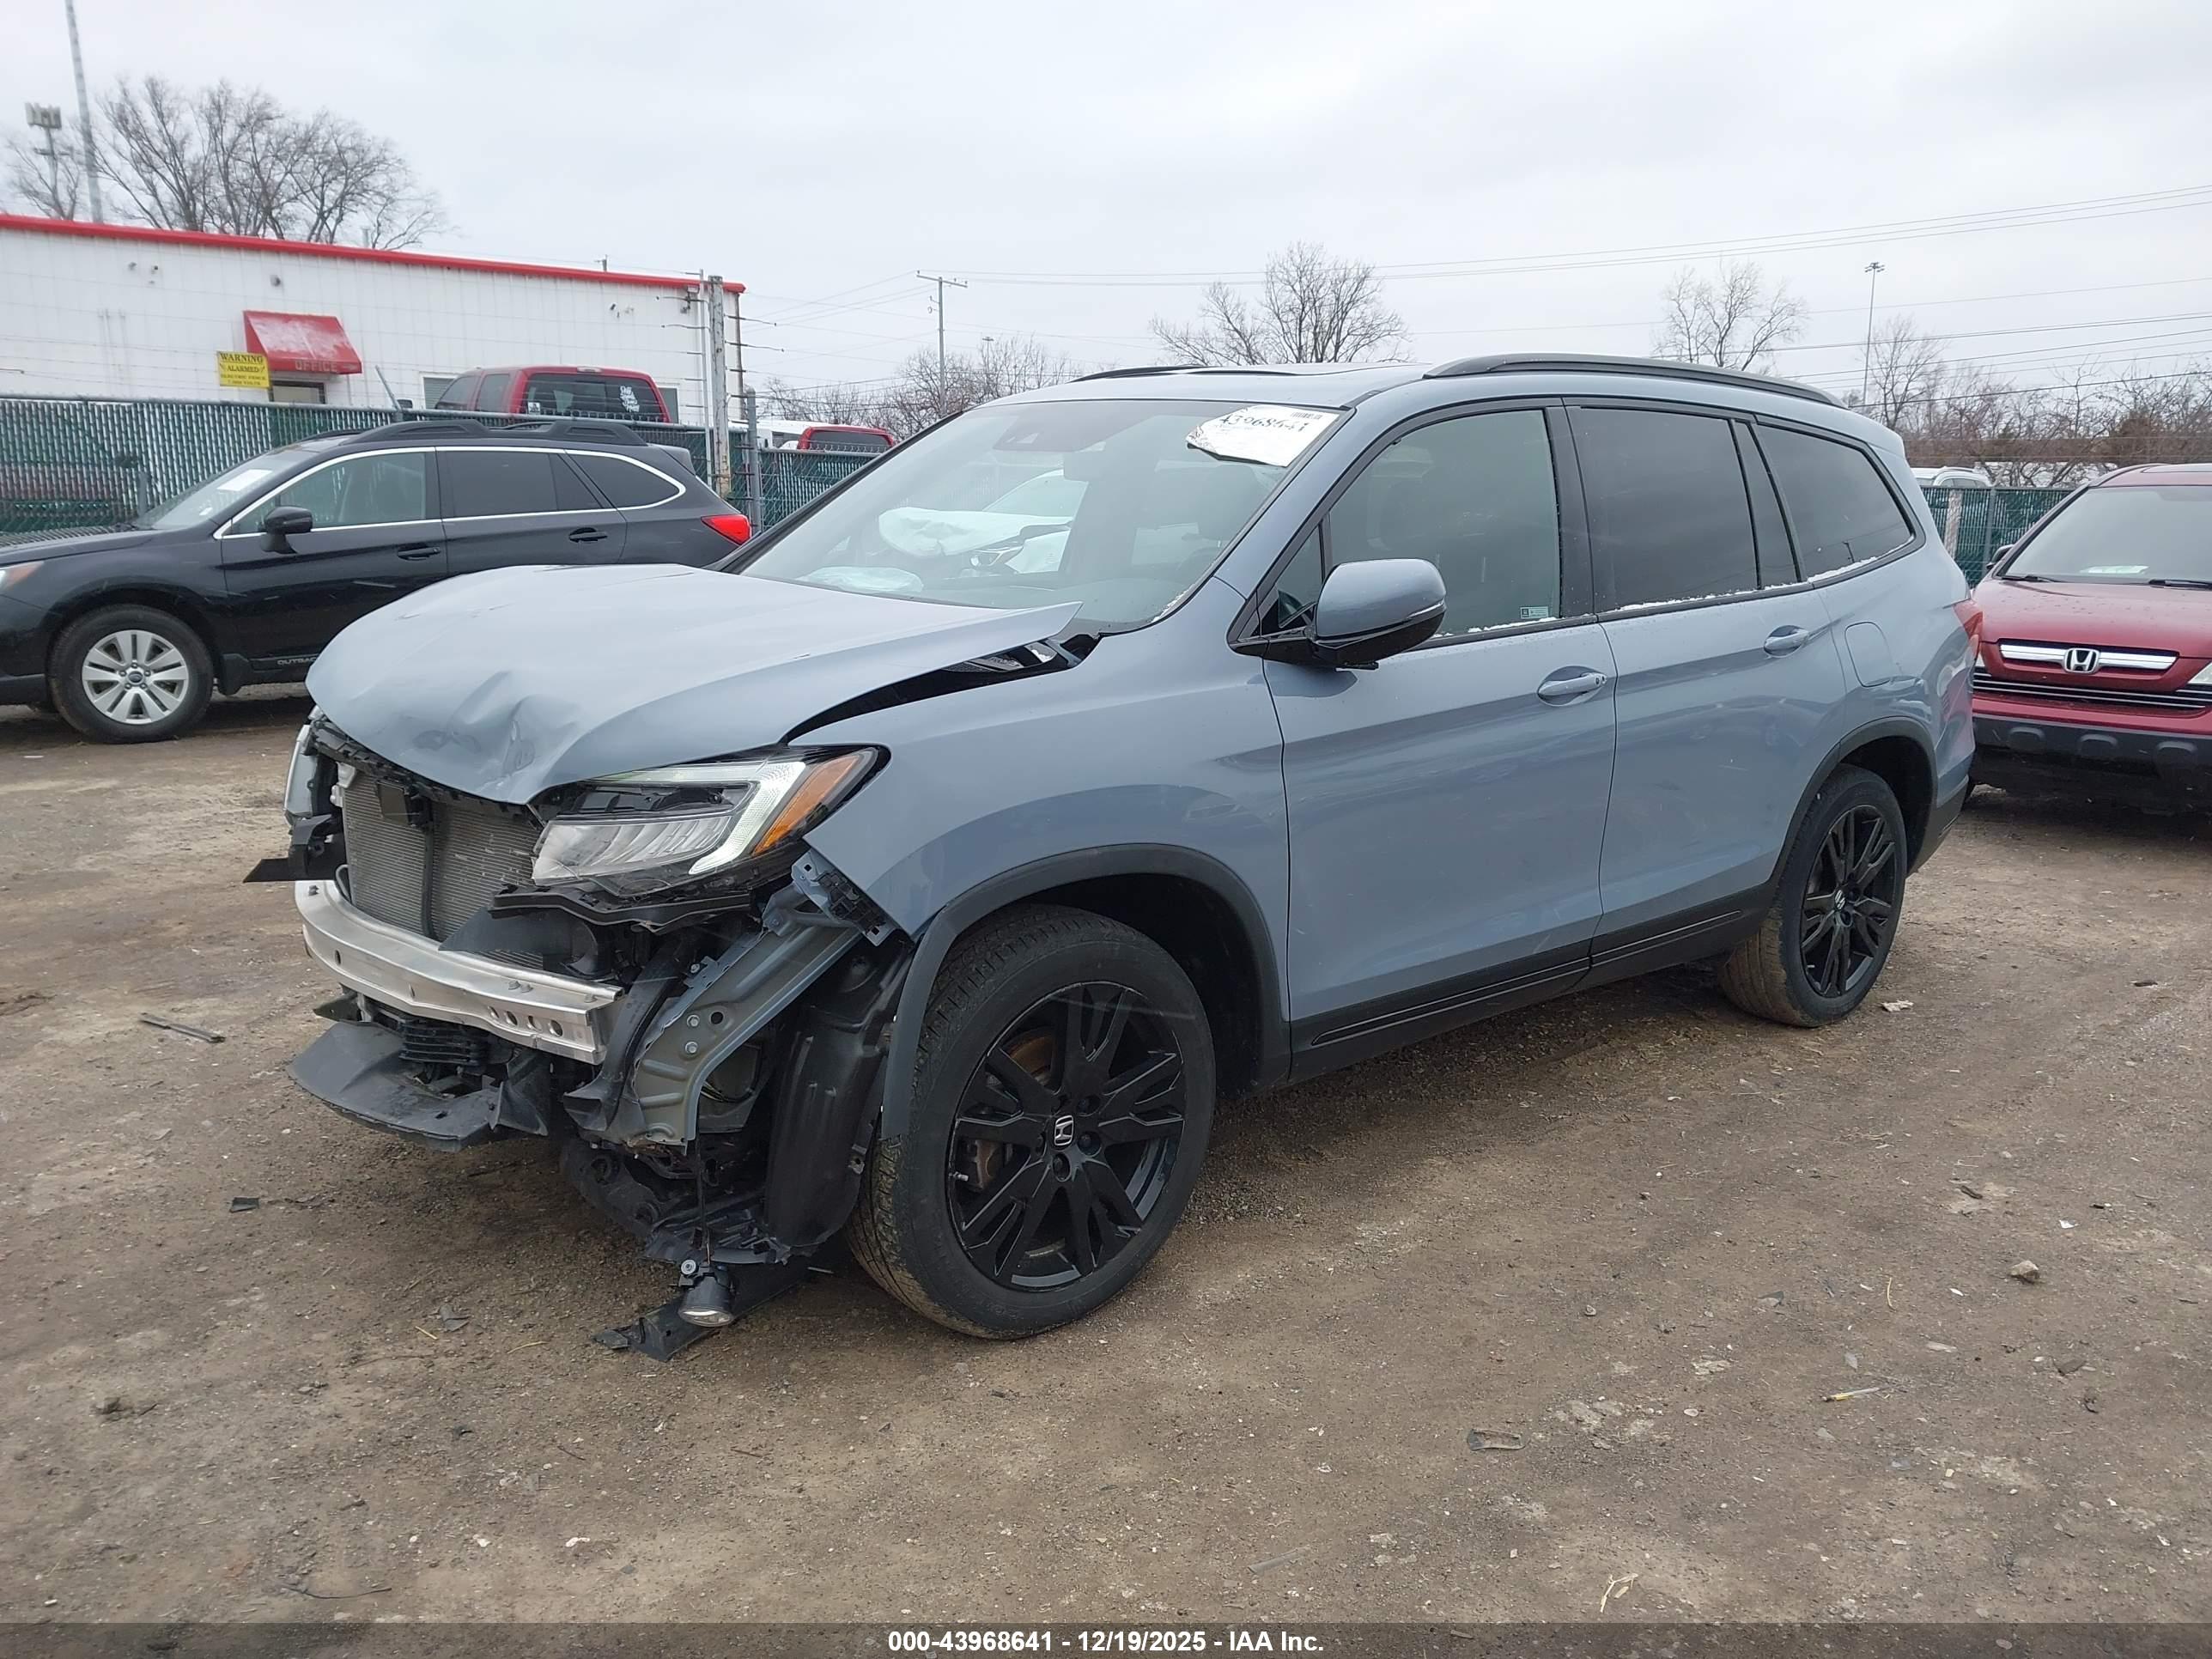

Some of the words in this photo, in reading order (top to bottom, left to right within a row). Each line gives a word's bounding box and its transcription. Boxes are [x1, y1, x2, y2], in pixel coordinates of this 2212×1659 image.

[220, 352, 264, 364] WARNING
[227, 364, 259, 373] ALARMED
[295, 359, 337, 372] OFFICE
[276, 656, 317, 665] OUTBAC
